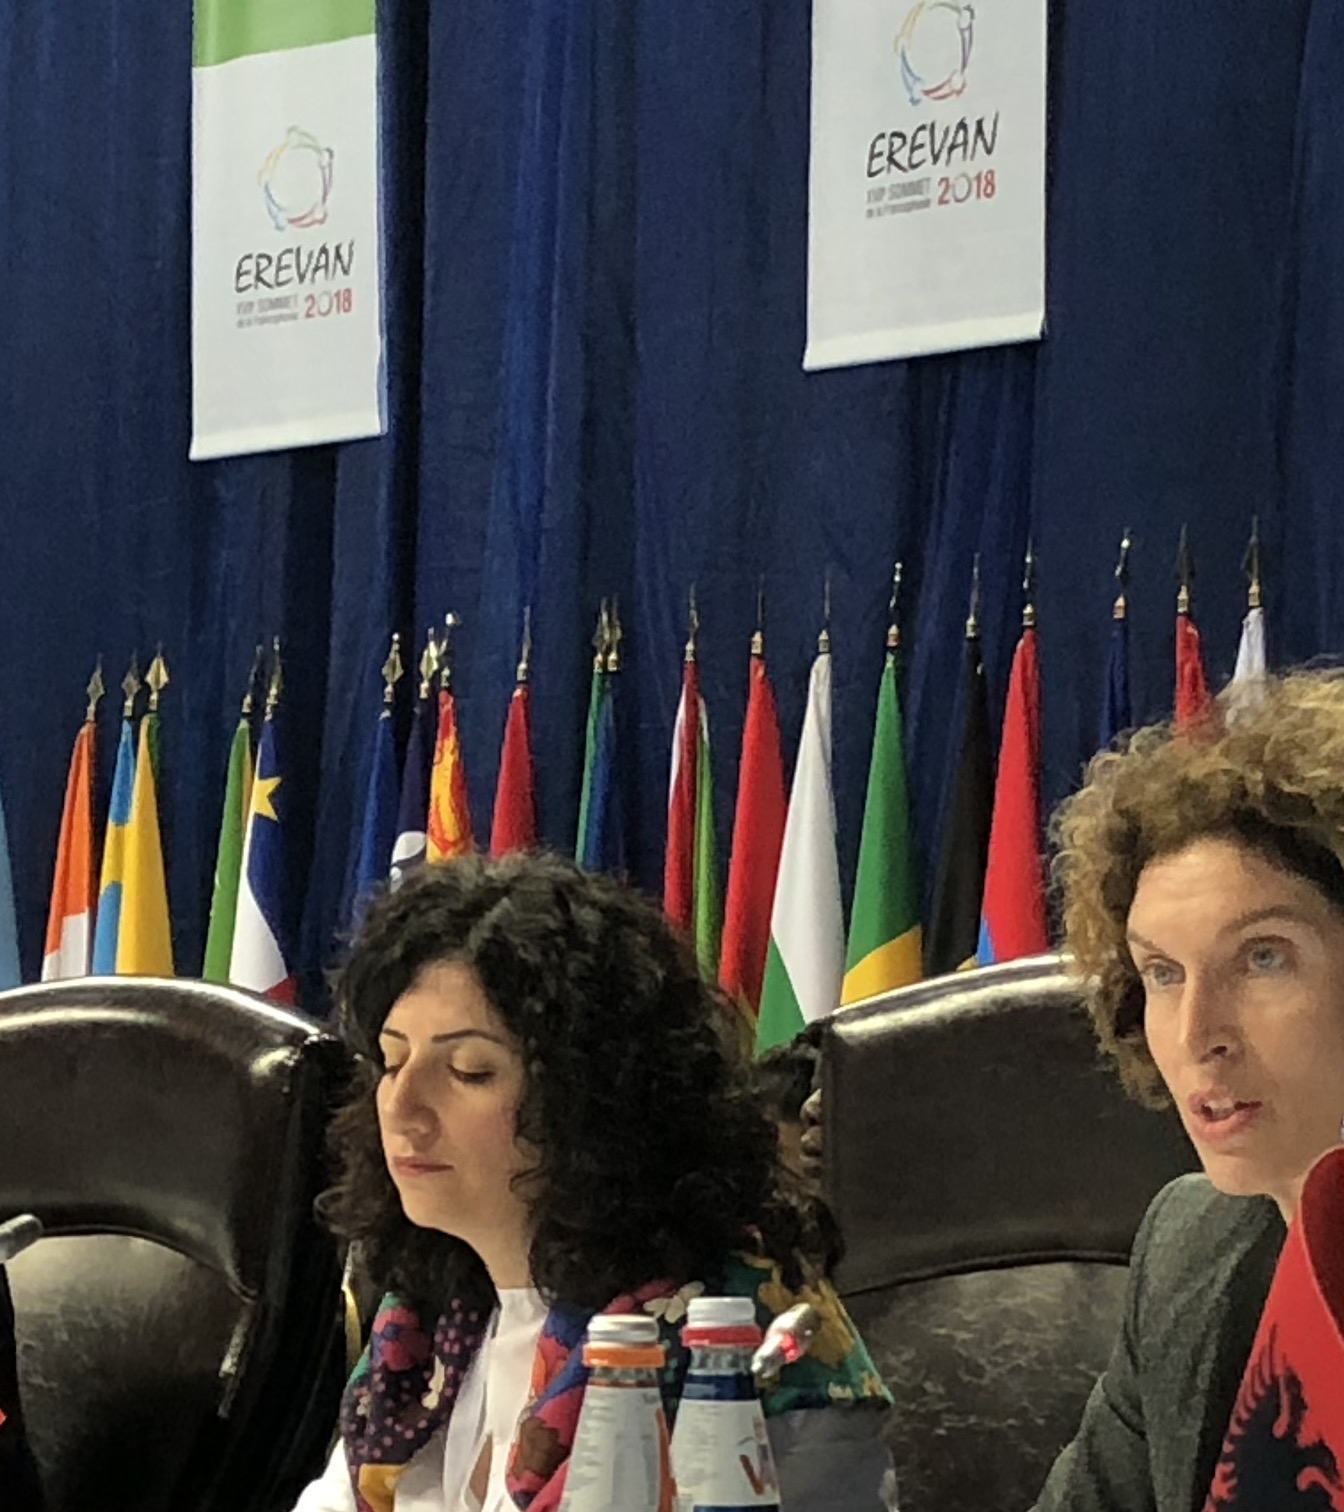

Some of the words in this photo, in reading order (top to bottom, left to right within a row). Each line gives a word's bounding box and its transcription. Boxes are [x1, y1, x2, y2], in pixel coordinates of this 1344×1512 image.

[866, 111, 999, 178] EREVAN
[937, 169, 996, 206] 2018
[235, 238, 354, 294] EREVAN
[304, 288, 353, 320] 2018
